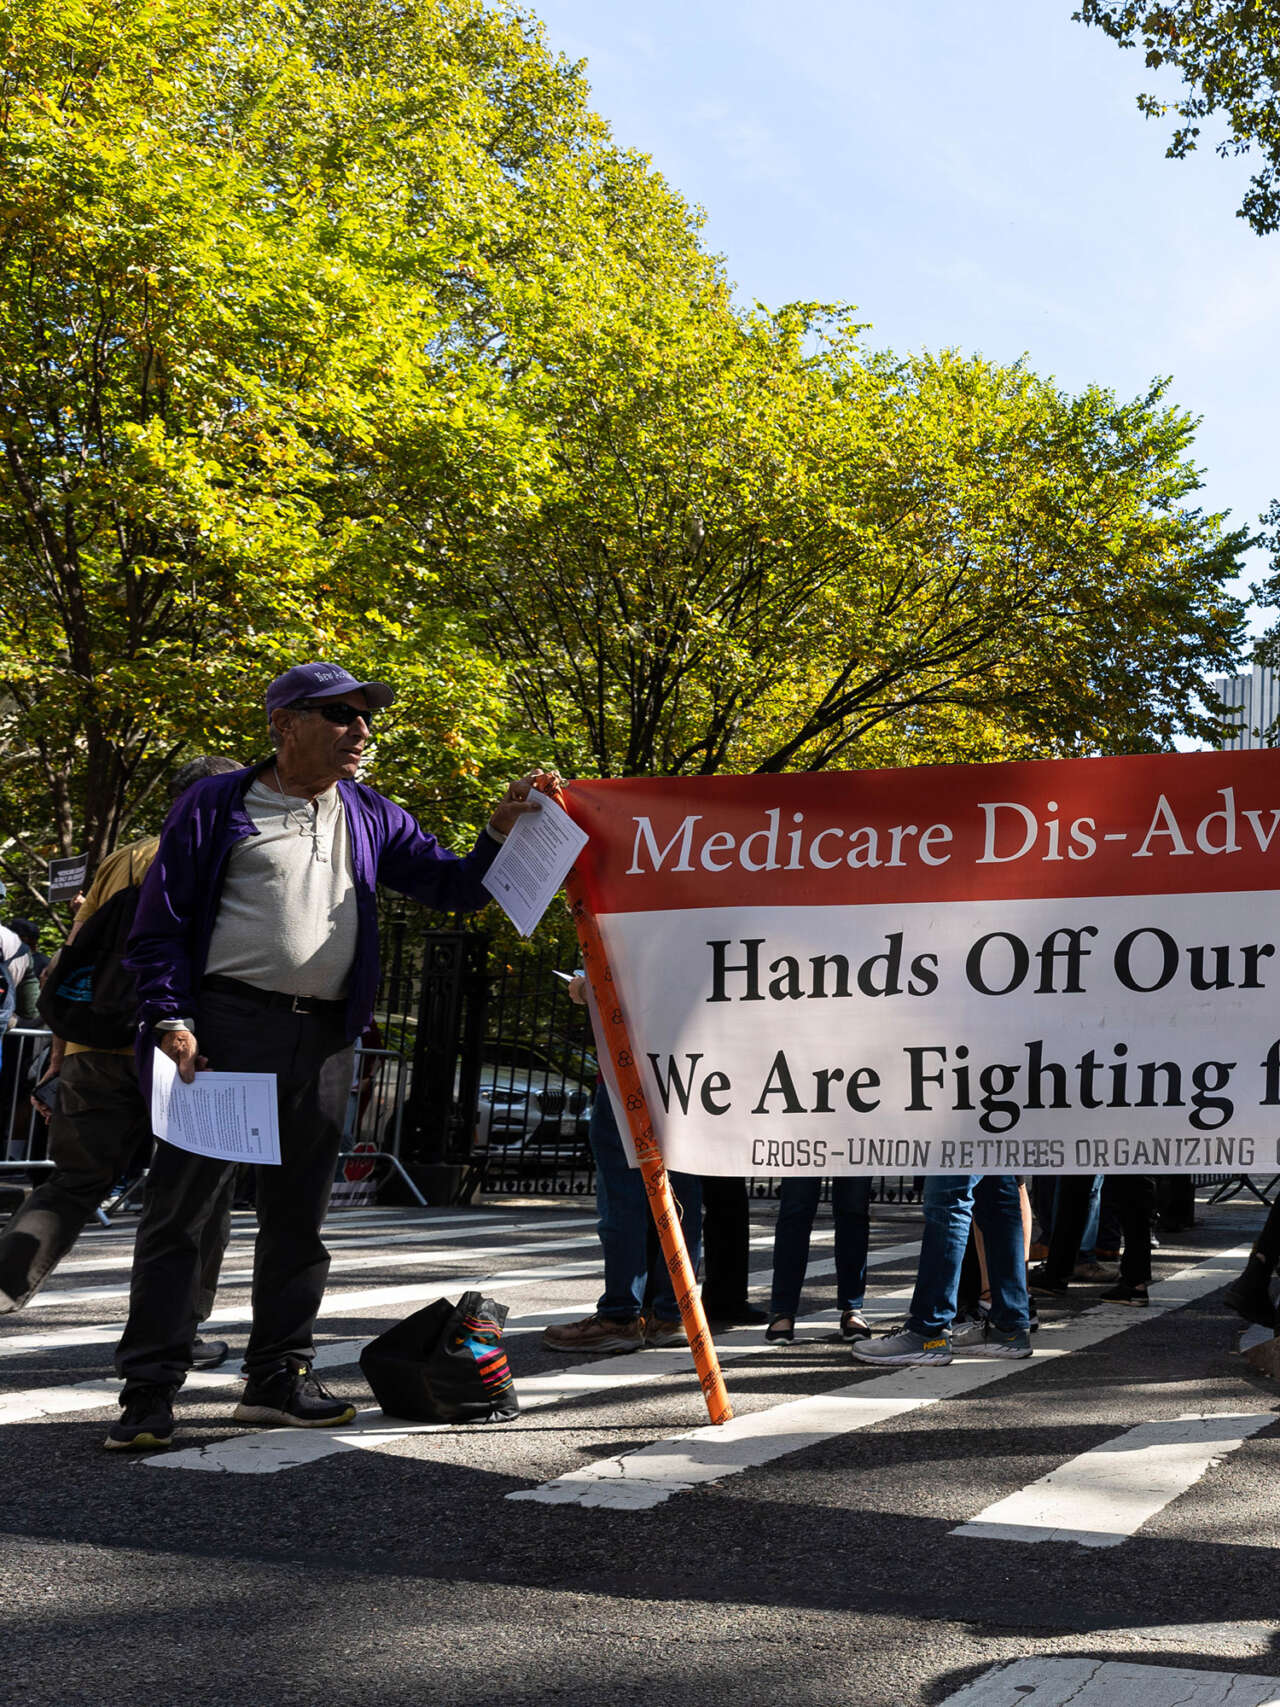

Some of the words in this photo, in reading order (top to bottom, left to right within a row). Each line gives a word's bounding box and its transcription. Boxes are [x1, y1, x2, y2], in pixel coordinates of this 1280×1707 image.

[626, 808, 953, 875] Medicare
[706, 932, 939, 1003] Hands
[965, 926, 1099, 996] Off
[1113, 927, 1276, 993] Our
[647, 1053, 732, 1117] We
[751, 1050, 881, 1114] Are
[903, 1039, 1238, 1134] Fighting
[751, 1137, 932, 1168] CROSS-UNION
[939, 1138, 1064, 1168] RETIREES
[1074, 1137, 1255, 1168] ORGANIZING
